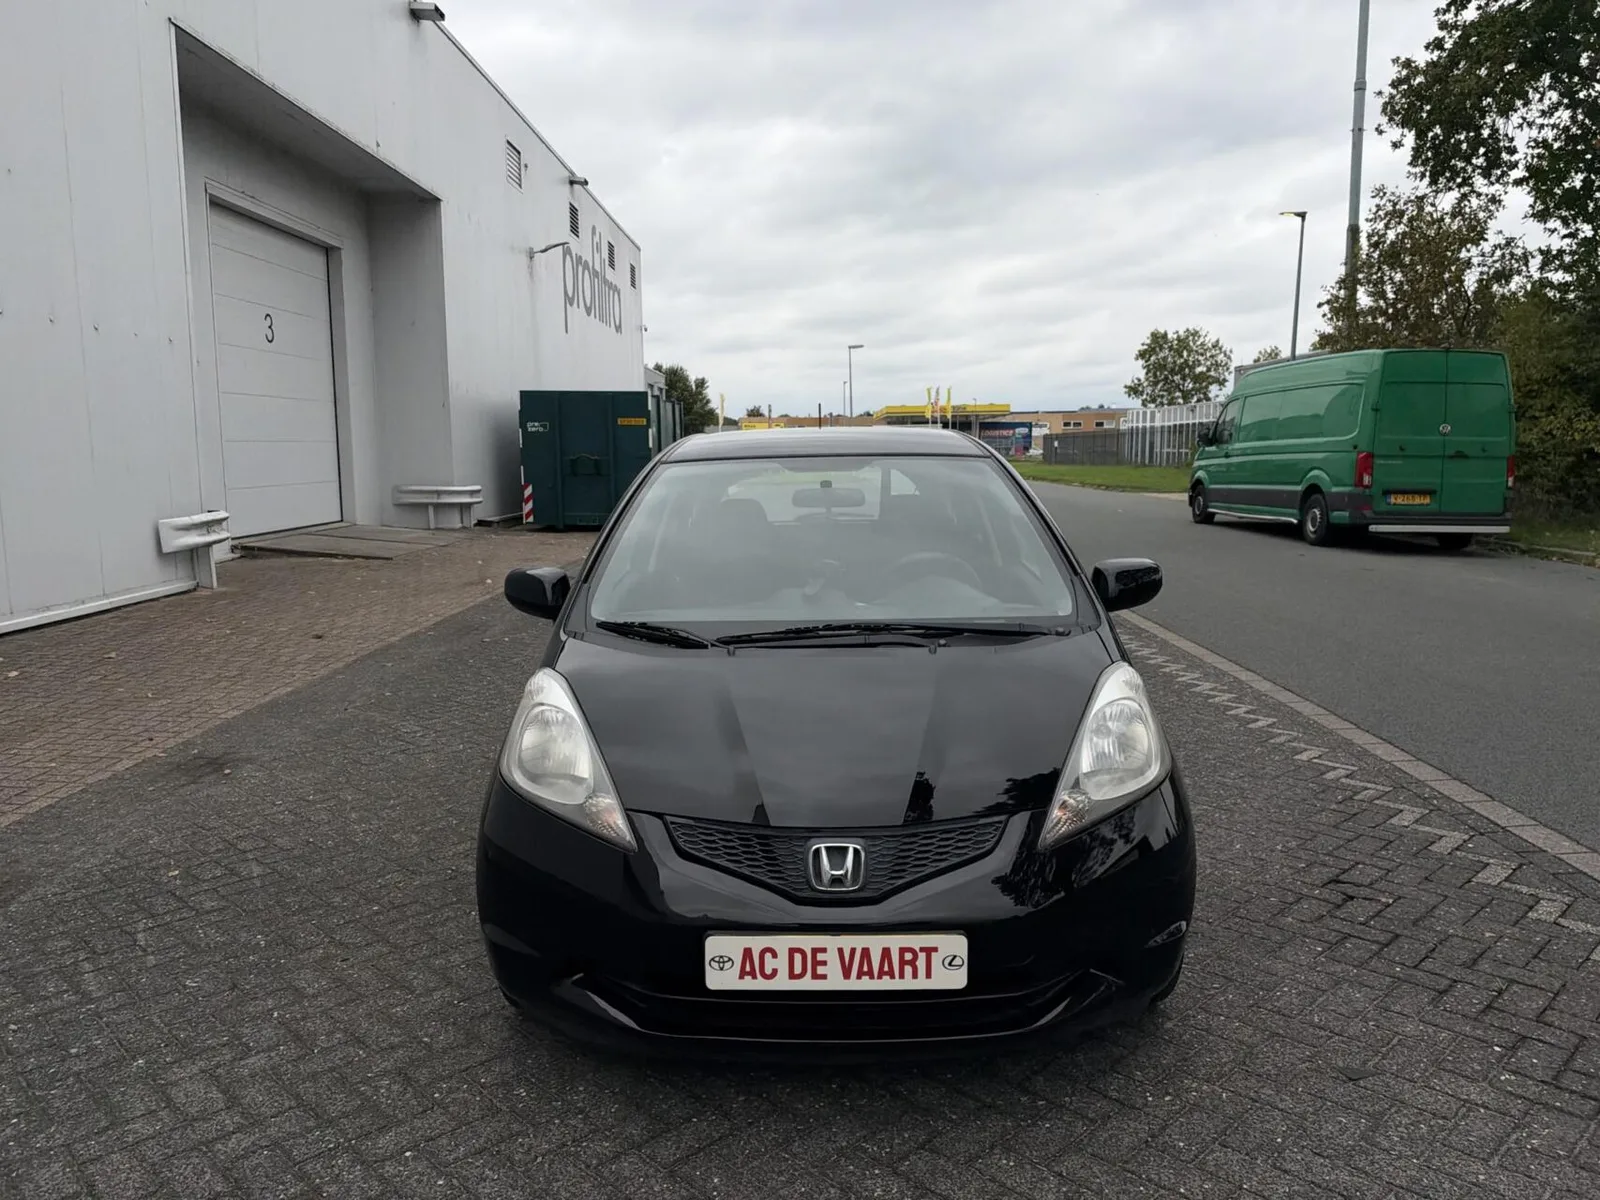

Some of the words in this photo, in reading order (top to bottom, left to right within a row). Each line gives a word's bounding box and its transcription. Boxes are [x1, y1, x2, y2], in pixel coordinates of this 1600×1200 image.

[562, 224, 622, 335] profiltra
[264, 313, 275, 343] 3
[738, 947, 778, 980] AC
[787, 947, 828, 980] DE
[837, 946, 938, 980] VAART
